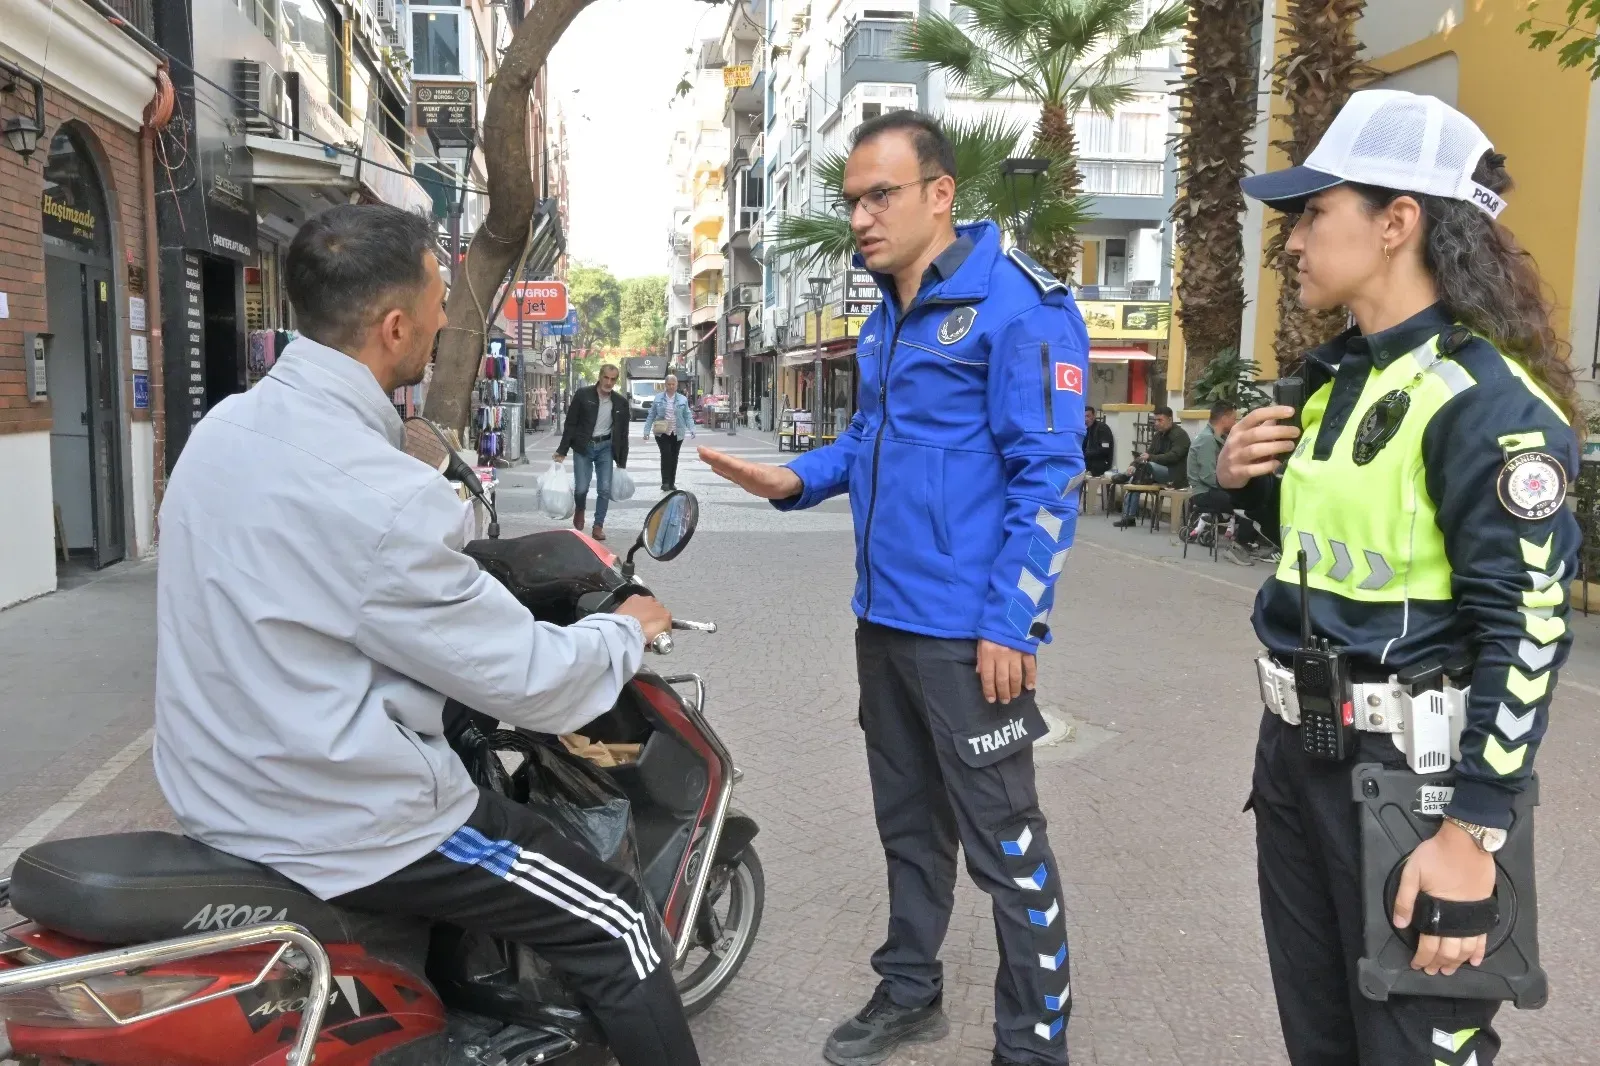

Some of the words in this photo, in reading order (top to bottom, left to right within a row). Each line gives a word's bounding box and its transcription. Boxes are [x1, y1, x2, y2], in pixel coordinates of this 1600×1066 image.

[43, 194, 95, 229] Haşimzade
[858, 288, 876, 298] UMUT
[525, 299, 546, 315] jet
[968, 717, 1028, 754] TRAFİK
[248, 990, 339, 1017] AROA
